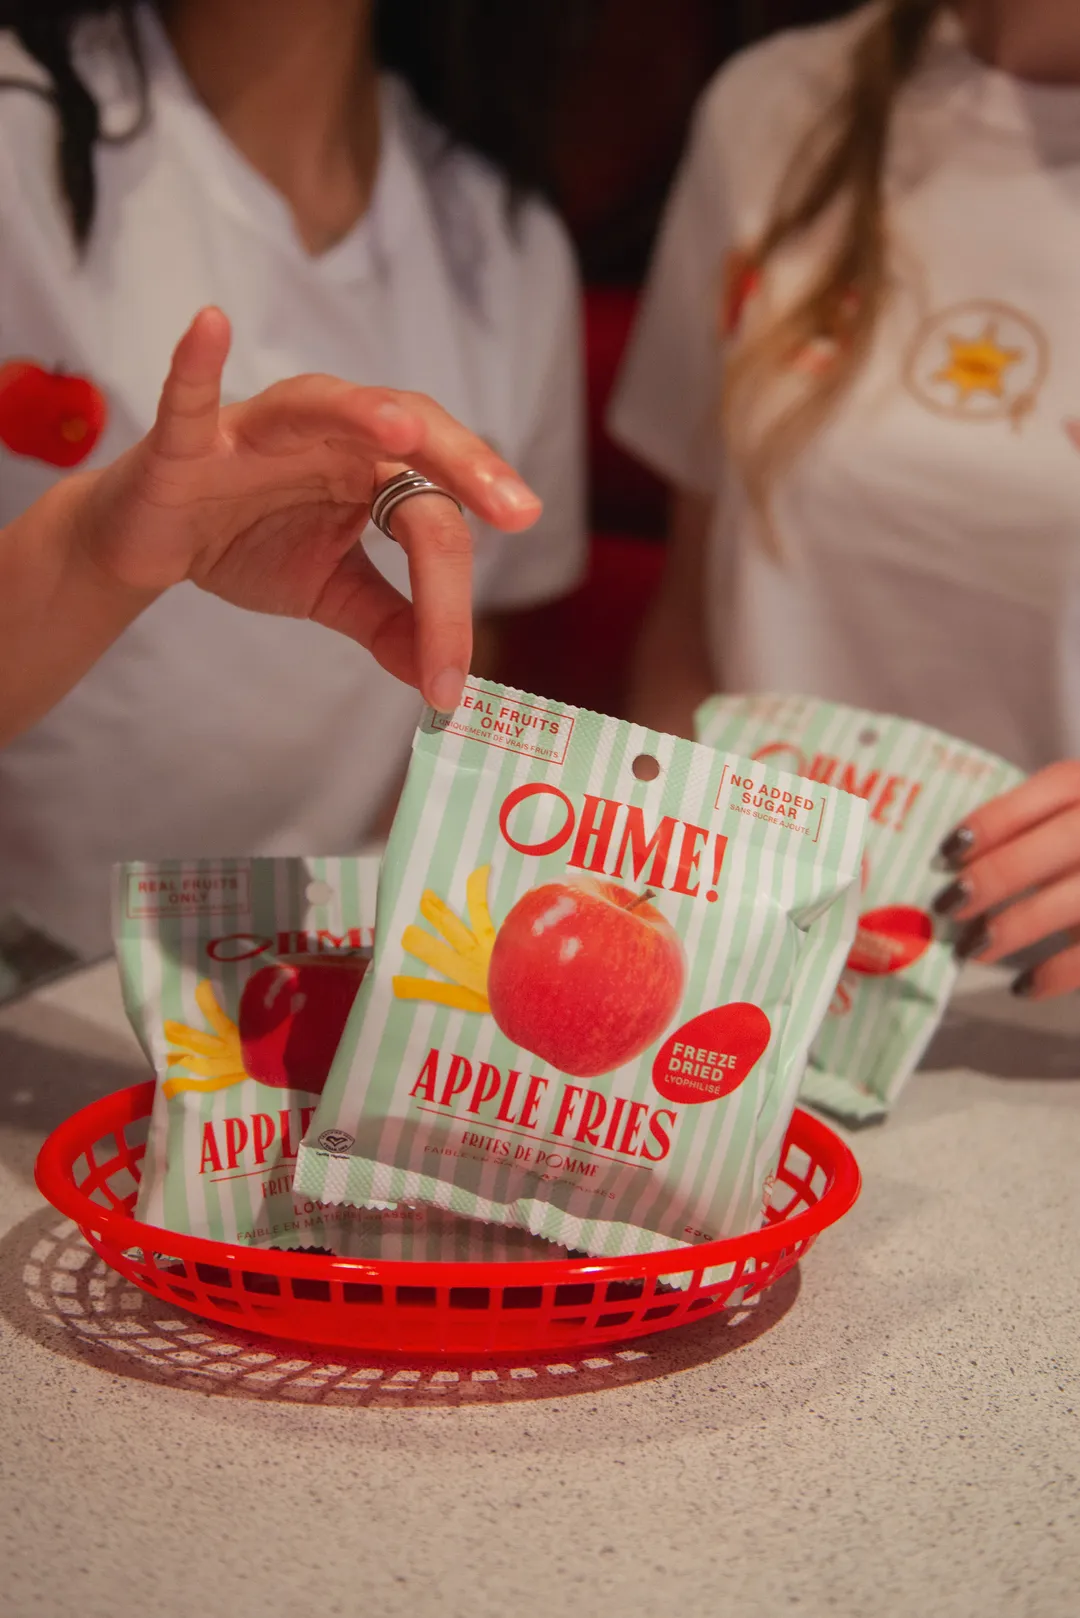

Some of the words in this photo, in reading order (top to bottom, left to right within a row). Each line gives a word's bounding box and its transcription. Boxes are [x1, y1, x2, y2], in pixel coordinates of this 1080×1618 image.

[463, 696, 494, 716] EAL
[499, 707, 560, 735] FRUITS
[481, 717, 525, 739] ONLY
[440, 719, 492, 739] UNIQUEMENT
[493, 734, 505, 743] DE
[505, 739, 529, 752] VRAIS
[530, 745, 559, 759] FRUITS
[730, 774, 754, 790] NO
[759, 784, 815, 811] ADDED
[742, 792, 798, 820] SUGAR
[730, 803, 751, 816] SANS
[752, 809, 778, 825] SUCRE
[779, 819, 811, 836] AJOUTÉ
[498, 783, 728, 903] OHME!
[138, 880, 176, 893] REAL
[183, 877, 239, 892] FRUITS
[206, 927, 375, 962] OHM
[668, 1057, 724, 1082] DRIED
[672, 1042, 738, 1069] FREEZE
[664, 1074, 721, 1095] LYOPHILISÉ
[409, 1048, 549, 1129] APPLE
[551, 1084, 678, 1162] FRIES
[461, 1131, 512, 1157] FRITES
[514, 1144, 534, 1162] DE
[536, 1153, 600, 1178] POMME
[261, 1174, 295, 1199] FRIT
[237, 1224, 280, 1242] FAIBLE
[284, 1219, 301, 1231] EN
